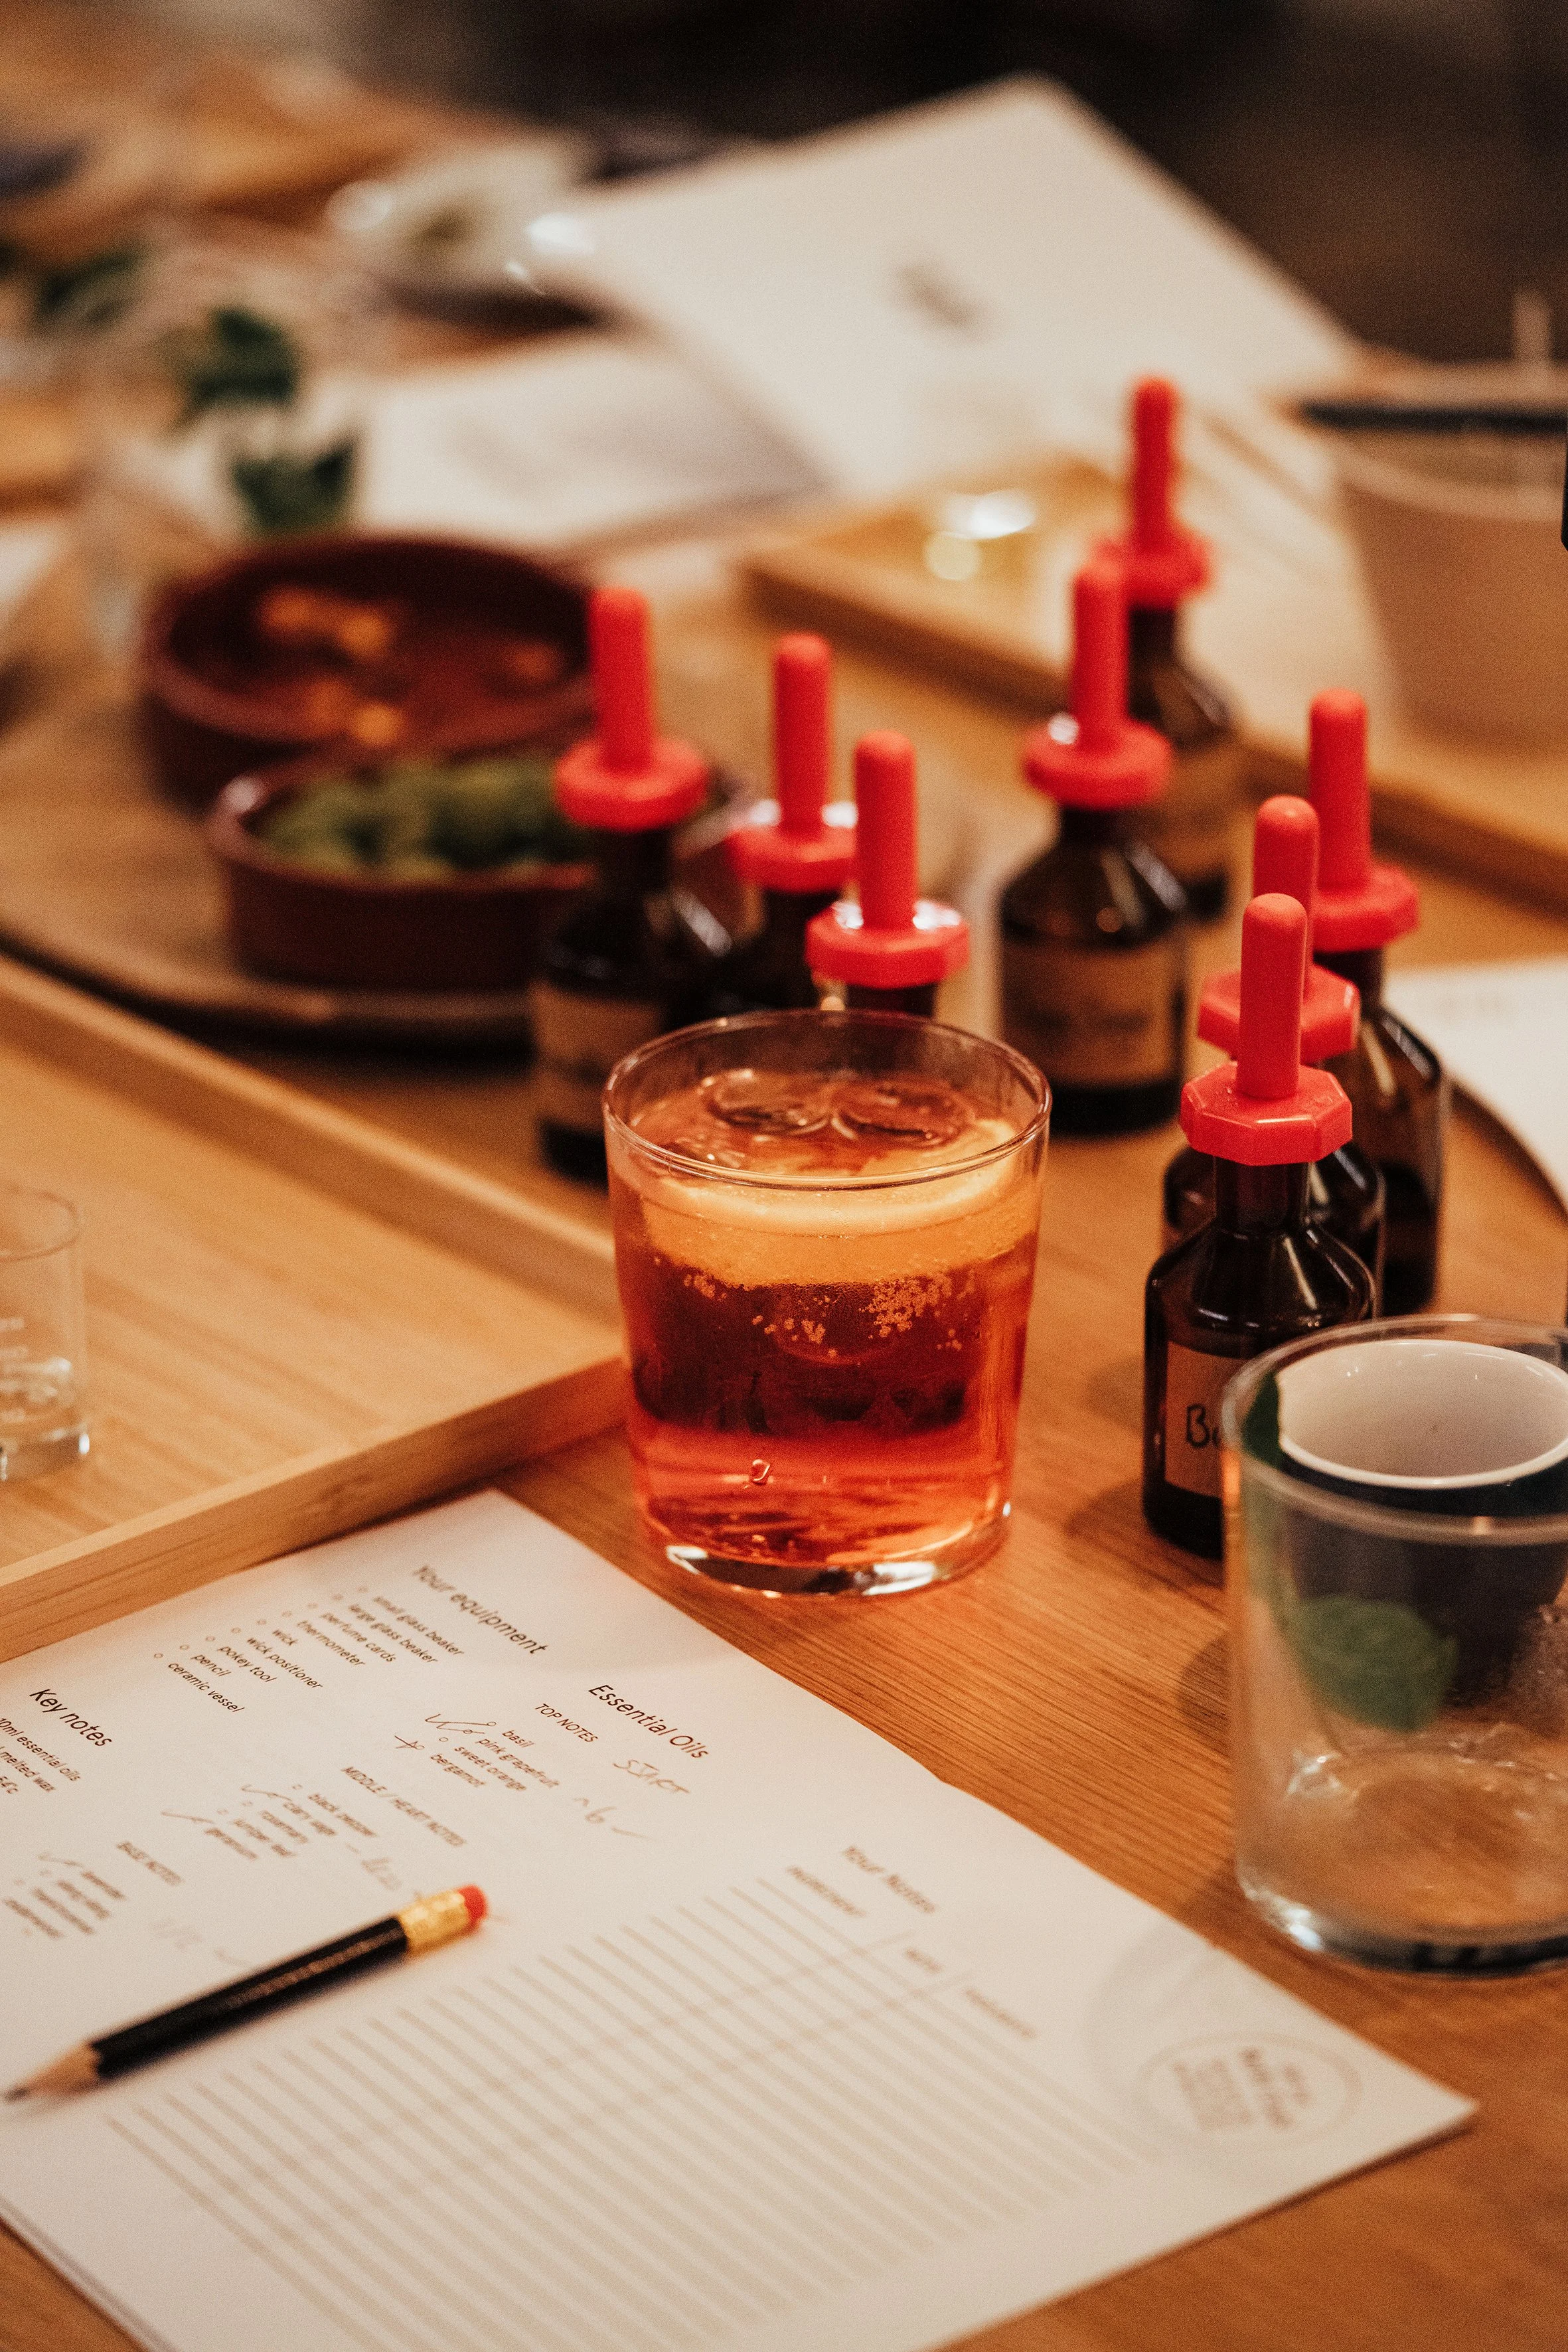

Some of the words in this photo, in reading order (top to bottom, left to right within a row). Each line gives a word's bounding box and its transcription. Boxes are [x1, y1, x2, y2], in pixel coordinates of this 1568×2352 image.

[272, 1629, 299, 1646] wick
[297, 1620, 365, 1666] thermometer
[319, 1612, 367, 1642] perfume
[365, 1642, 396, 1662] cards
[370, 1622, 402, 1640] glass
[400, 1638, 438, 1663] beaker
[426, 1630, 464, 1655] beaker
[449, 1593, 548, 1654] equipment
[191, 1655, 232, 1677] pencil
[217, 1646, 254, 1668] pokey
[250, 1666, 277, 1682] tool
[246, 1638, 273, 1654] wick
[267, 1654, 323, 1688] positioner
[168, 1662, 210, 1691] ceramic
[208, 1690, 245, 1712] vessel
[29, 1689, 68, 1713] Key
[60, 1713, 112, 1747] notes
[502, 1730, 535, 1748] basil
[535, 1703, 563, 1718] TOP
[556, 1718, 599, 1743] NOTES
[588, 1684, 678, 1736] Essential
[670, 1735, 709, 1759] Oils
[0, 1751, 40, 1778] melted
[17, 1736, 66, 1768] essential
[59, 1767, 81, 1782] oils
[341, 1766, 388, 1793] MIDDLE
[431, 1753, 486, 1787] bergamot
[454, 1746, 491, 1768] sweet
[487, 1766, 527, 1791] orange
[475, 1739, 507, 1754] pink
[499, 1753, 560, 1787] grapefruit
